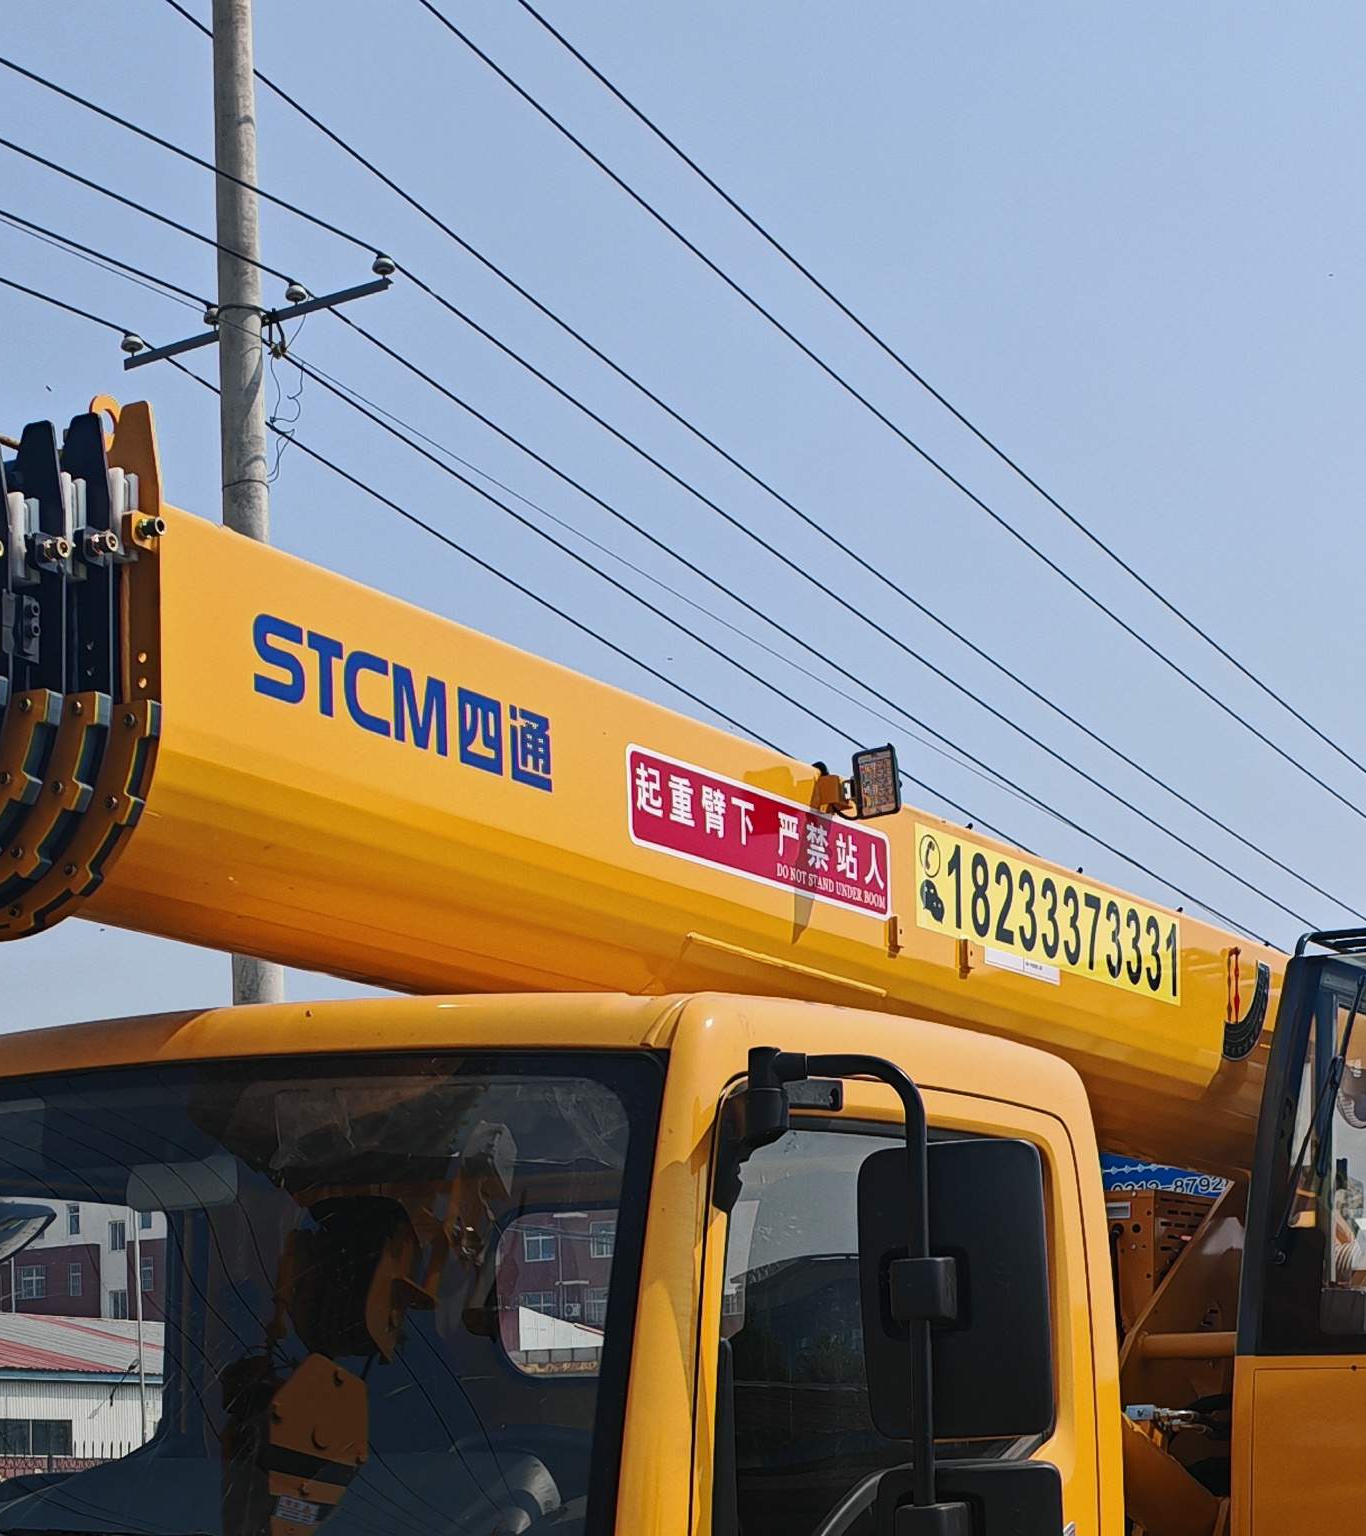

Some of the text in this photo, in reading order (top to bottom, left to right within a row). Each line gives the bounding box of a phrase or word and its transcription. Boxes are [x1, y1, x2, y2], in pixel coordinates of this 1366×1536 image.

[635, 762, 886, 890] 起重臂下 严禁站人
[776, 863, 887, 910] DO NOT STAND UNDER BOOM
[947, 844, 1177, 997] 18233373331
